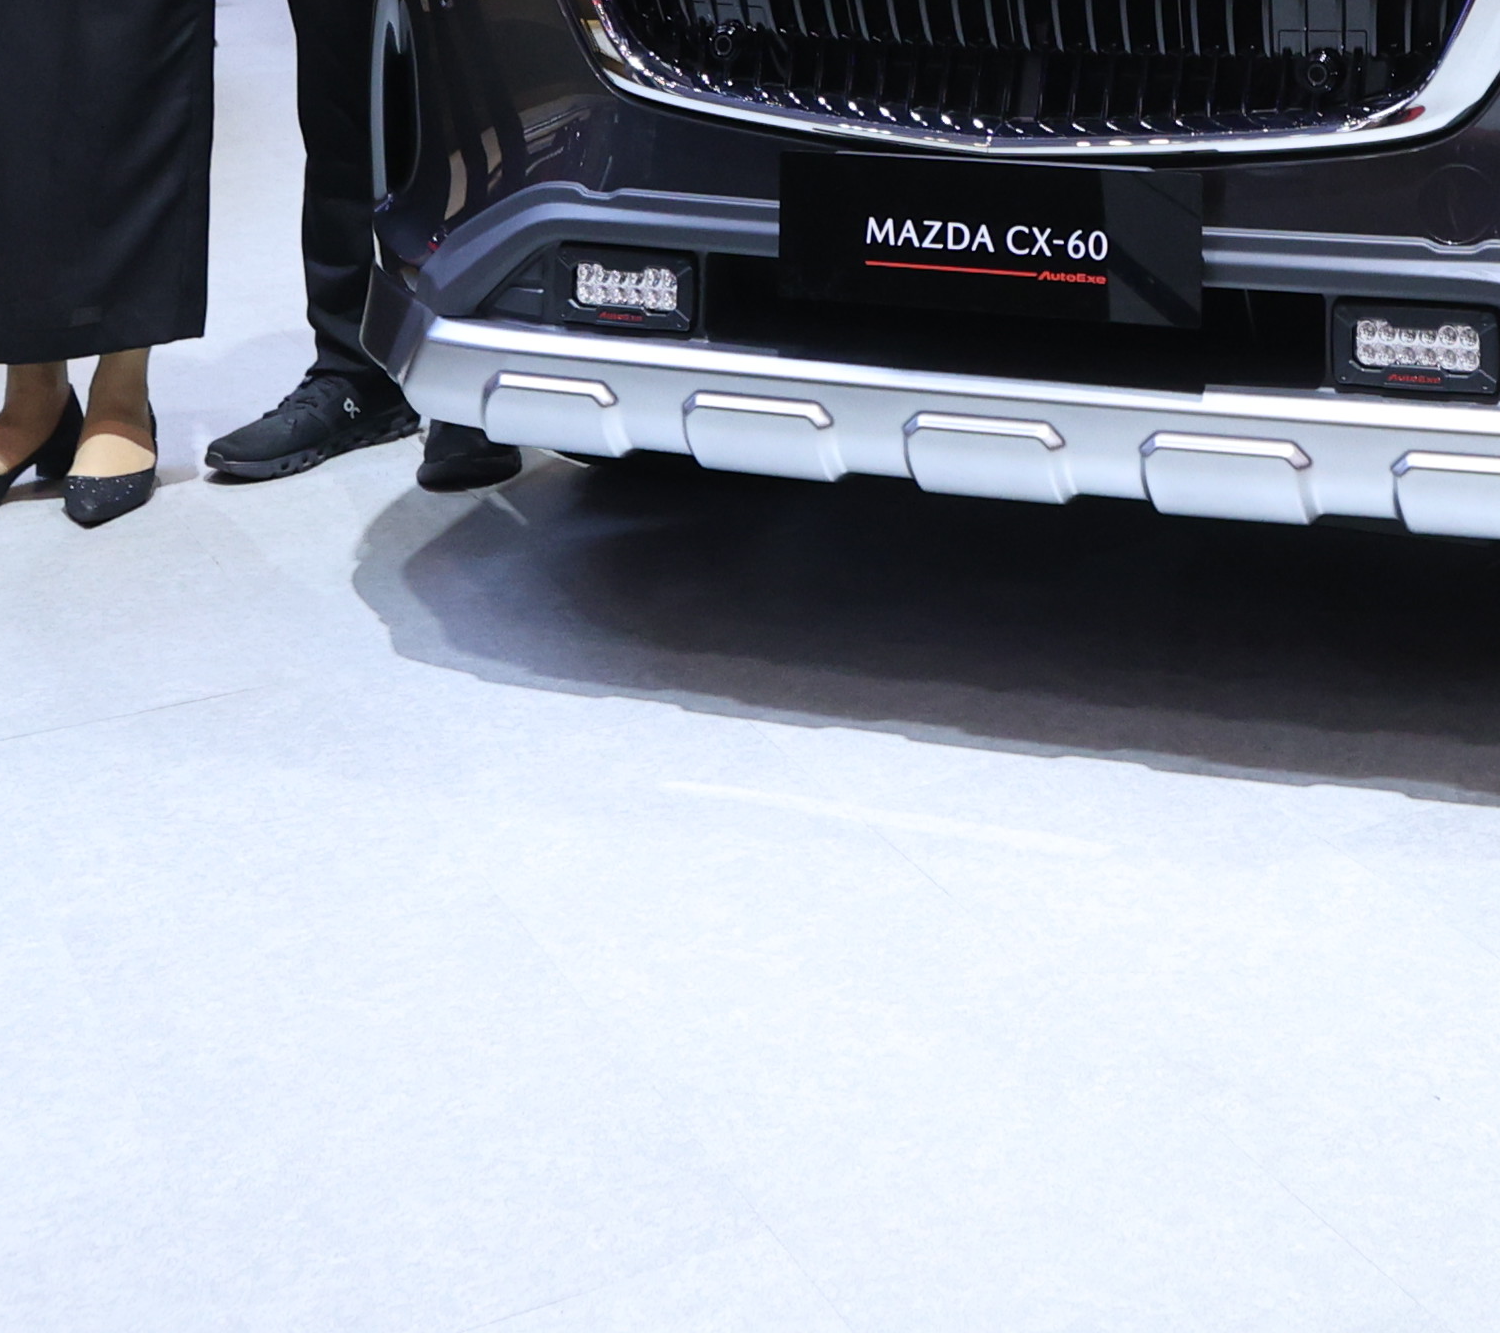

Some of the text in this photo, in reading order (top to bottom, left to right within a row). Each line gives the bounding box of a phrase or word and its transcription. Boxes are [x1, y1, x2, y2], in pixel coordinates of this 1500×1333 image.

[866, 216, 1108, 261] MAZDA CX-60
[1037, 270, 1107, 284] AutoExe
